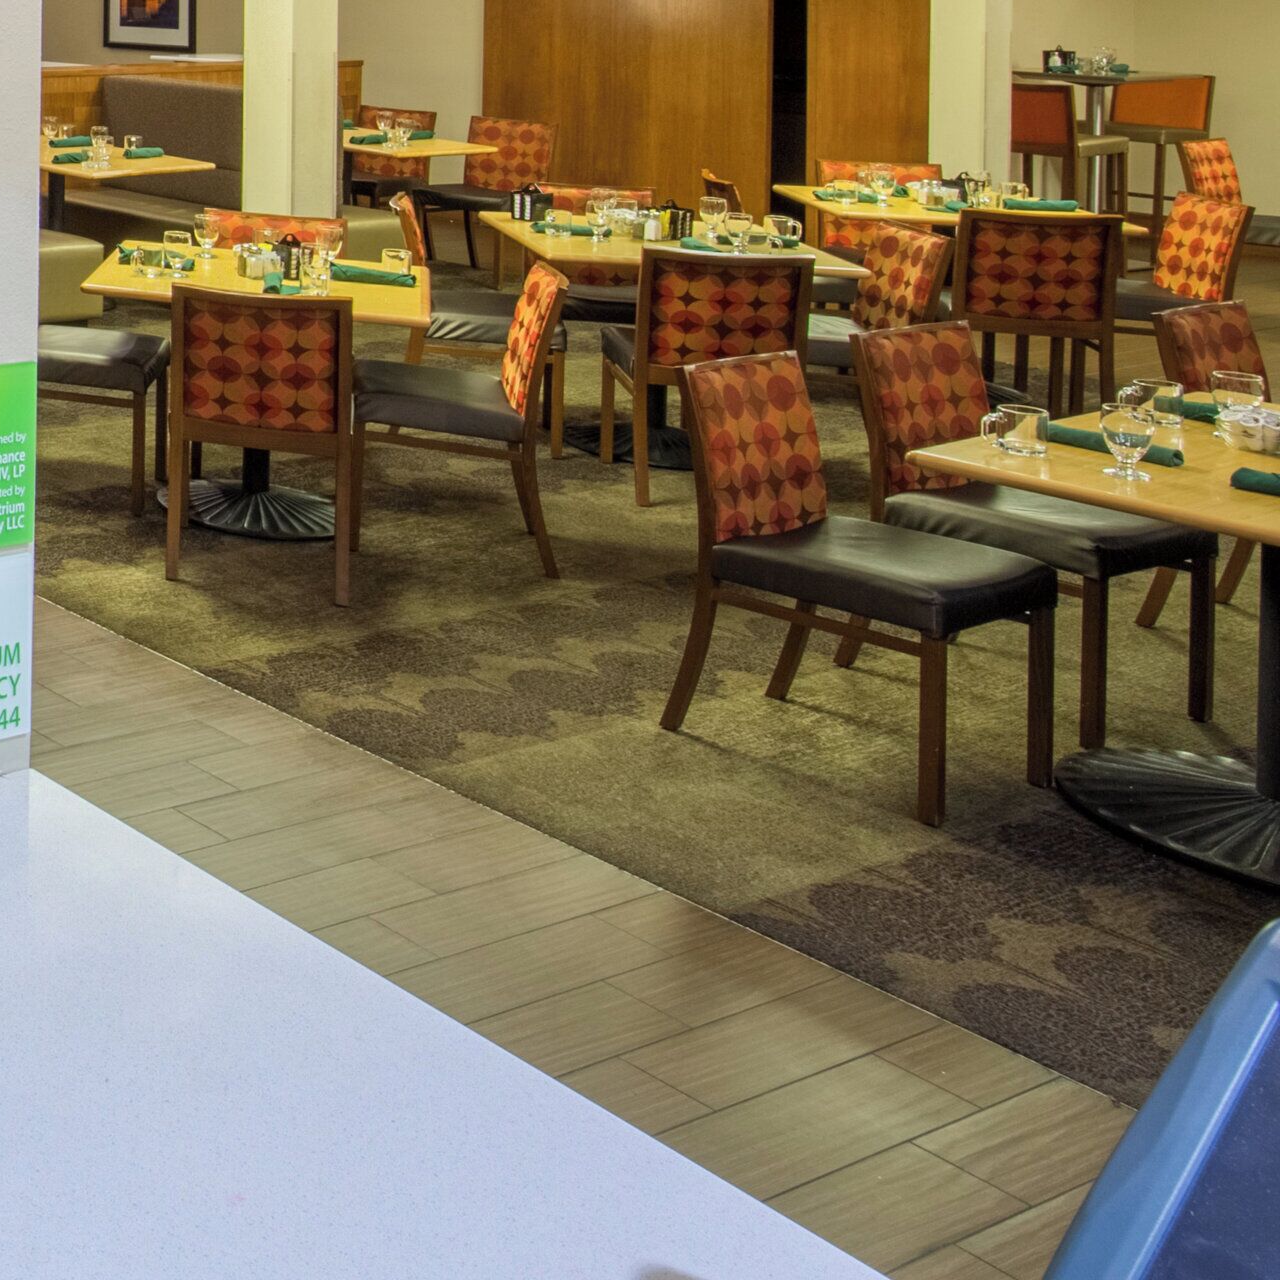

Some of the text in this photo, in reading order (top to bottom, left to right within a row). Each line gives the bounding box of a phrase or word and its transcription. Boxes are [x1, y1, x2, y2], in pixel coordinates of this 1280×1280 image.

[15, 431, 27, 444] by
[13, 464, 26, 478] LP
[14, 484, 26, 497] by
[6, 515, 25, 531] LLC
